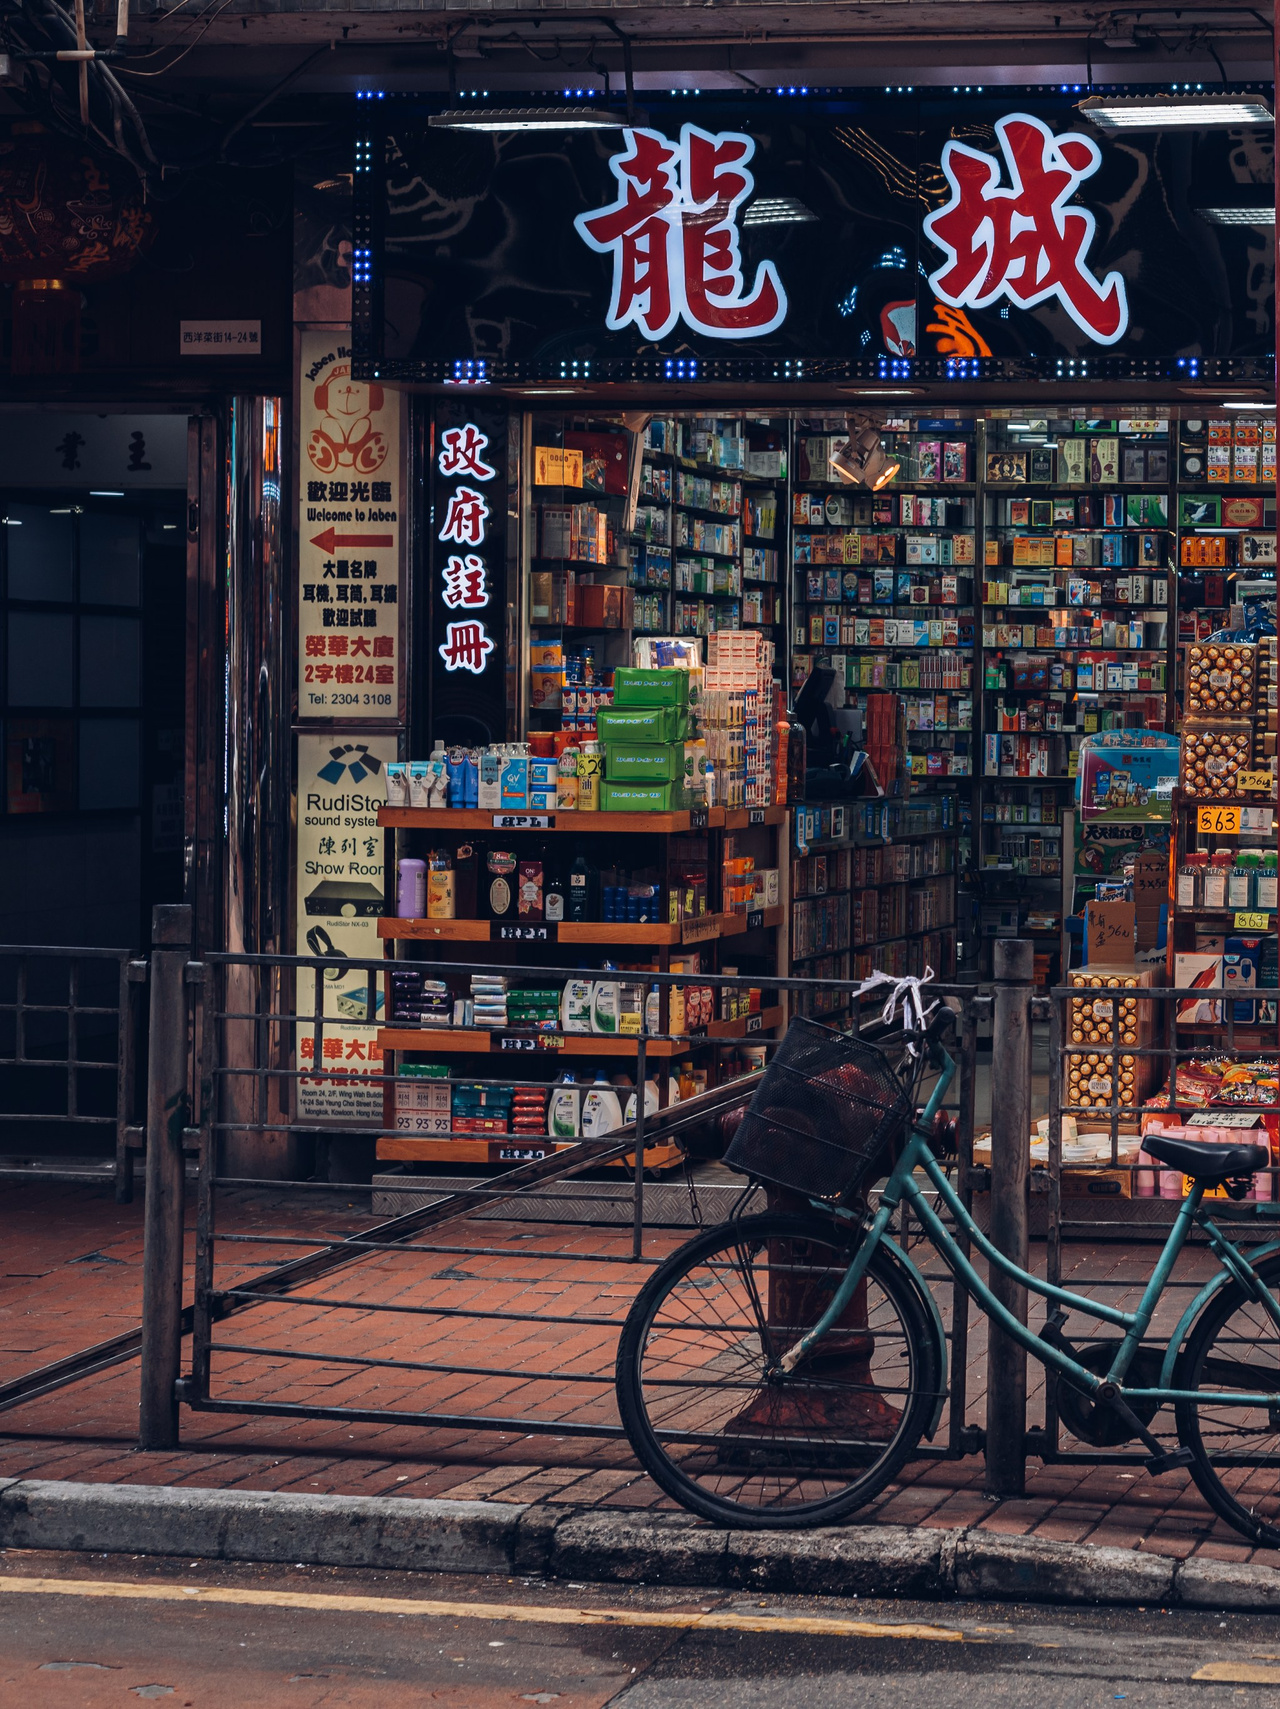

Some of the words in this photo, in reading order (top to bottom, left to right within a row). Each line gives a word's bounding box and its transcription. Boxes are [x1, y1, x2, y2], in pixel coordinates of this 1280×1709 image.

[183, 331, 259, 344] 西洋菜街14-24號
[304, 352, 336, 382] Jaben
[307, 481, 392, 503] 歡迎光臨
[307, 508, 352, 521] Welcome
[355, 508, 366, 521] to
[367, 508, 397, 521] Jaben
[438, 423, 497, 674] 政府註冊
[322, 560, 377, 579] 大量名牌
[322, 608, 377, 627] 歡迎試聽
[305, 635, 395, 658] 榮華大廈
[304, 664, 395, 684] 2字樓24室
[308, 693, 328, 705] Tel:
[331, 693, 359, 705] 2304
[363, 693, 392, 705] 3108
[506, 773, 520, 782] QV
[305, 815, 341, 826] sound
[318, 836, 379, 857] 陳列室
[305, 861, 345, 875] Show
[302, 1089, 318, 1097] Room
[338, 1090, 353, 1099] Wing
[366, 1091, 383, 1099] Buildin
[587, 1099, 602, 1107] Dove
[355, 1110, 371, 1118] Hong
